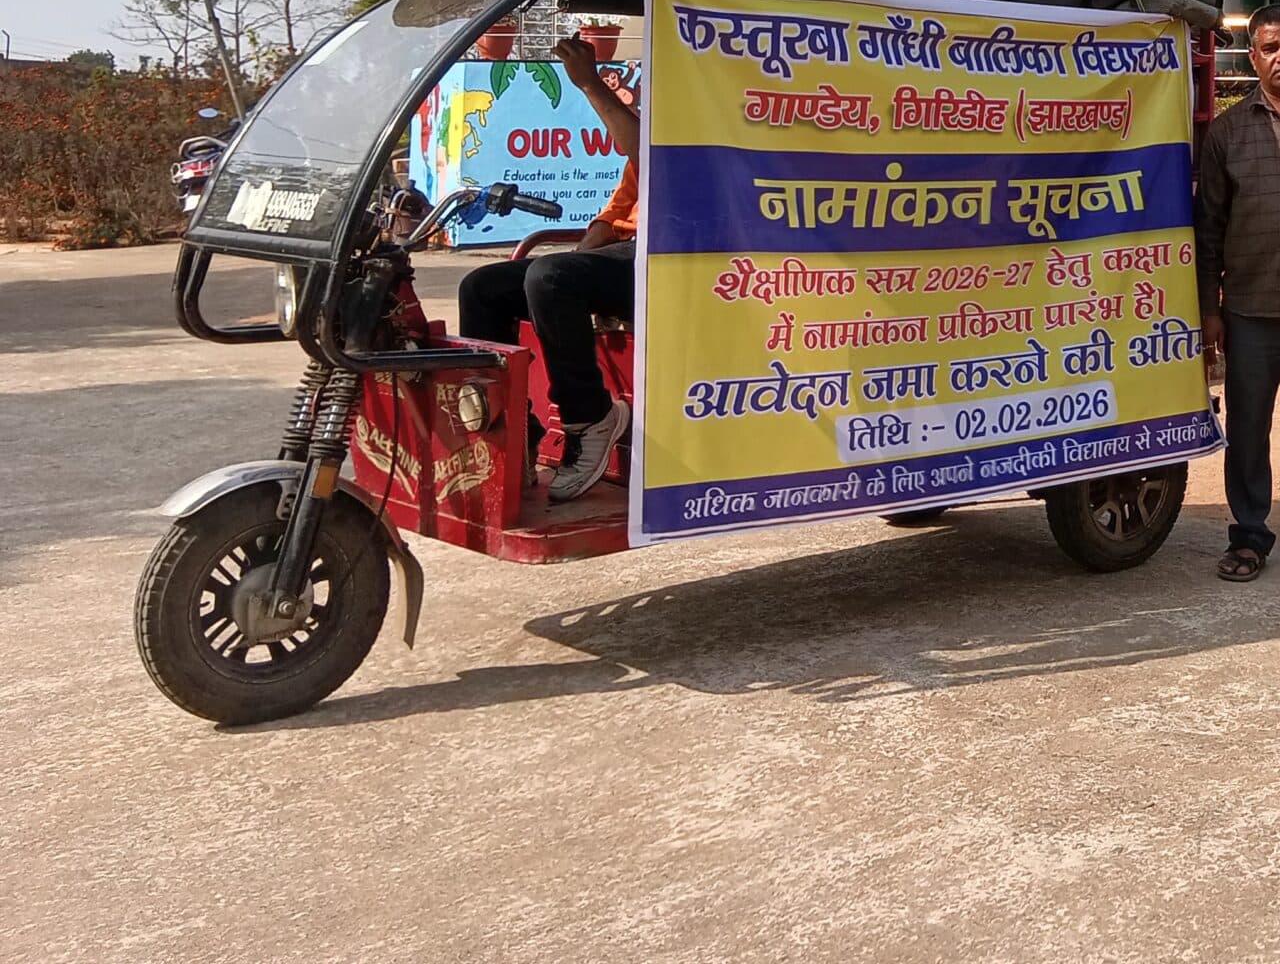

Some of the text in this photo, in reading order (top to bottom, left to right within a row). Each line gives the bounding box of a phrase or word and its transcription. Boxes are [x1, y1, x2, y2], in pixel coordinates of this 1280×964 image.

[674, 5, 1179, 78] कस्तूरबा गाँधी बालिका विद्यालय
[745, 85, 880, 133] गाण्डेय,
[893, 87, 1009, 132] गिरिडीह
[508, 128, 571, 158] OUR
[503, 167, 619, 181] Education is the most
[552, 189, 571, 203] you
[576, 189, 597, 199] can
[753, 162, 1145, 240] नामांकन सूचना
[713, 243, 1192, 303] शैक्षणिक सत्र 2026-27 हेतु कक्षा 6
[766, 313, 795, 351] में
[803, 311, 929, 350] नामांकन
[937, 302, 1035, 342] प्रक्रिया
[1044, 290, 1124, 330] प्रारंभ
[685, 361, 851, 420] आवेदन
[863, 364, 938, 401] जमा
[950, 339, 1049, 392] करने
[1062, 329, 1115, 376] की
[848, 414, 912, 451] तिथि
[684, 487, 757, 520] अधिक
[763, 473, 861, 509] जानकारी
[866, 468, 886, 496] के
[892, 466, 925, 493] लिए
[931, 455, 973, 487] अपने
[980, 442, 1056, 478] नजदीकी
[1063, 435, 1131, 464] विद्यालय
[1135, 425, 1151, 451] से
[1156, 417, 1198, 447] संपर्क
